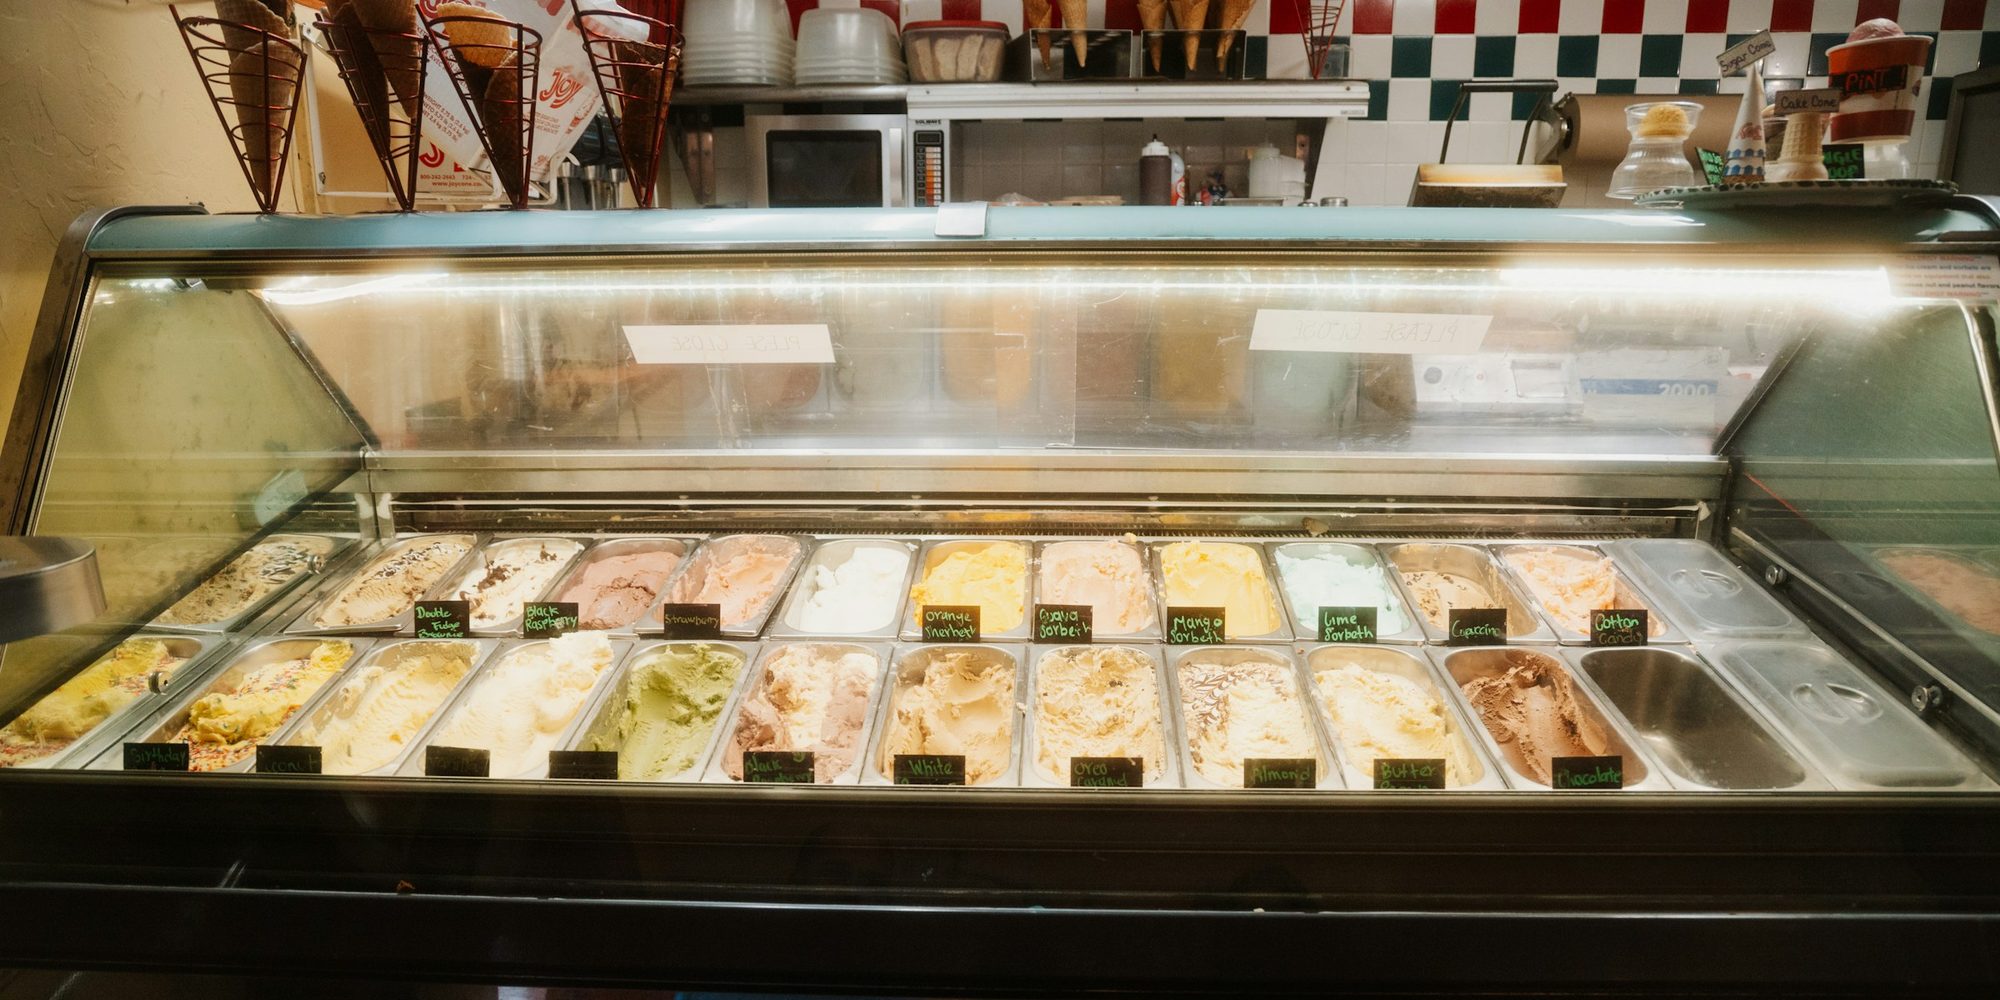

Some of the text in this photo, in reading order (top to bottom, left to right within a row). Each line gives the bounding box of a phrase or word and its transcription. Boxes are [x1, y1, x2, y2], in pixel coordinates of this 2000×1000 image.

[1719, 51, 1747, 72] Sugar
[1779, 94, 1836, 109] Cake Cone
[416, 606, 452, 619] Double
[526, 605, 560, 618] Black
[1039, 607, 1079, 624] Guava
[431, 621, 460, 631] Fudge
[525, 615, 578, 632] Raspberry
[1173, 615, 1223, 632] Mango
[1594, 612, 1639, 631] Cotton
[907, 757, 953, 777] White
[1251, 766, 1312, 783] Almond
[1381, 763, 1435, 780] Butter
[1557, 766, 1621, 788] Chocolate
